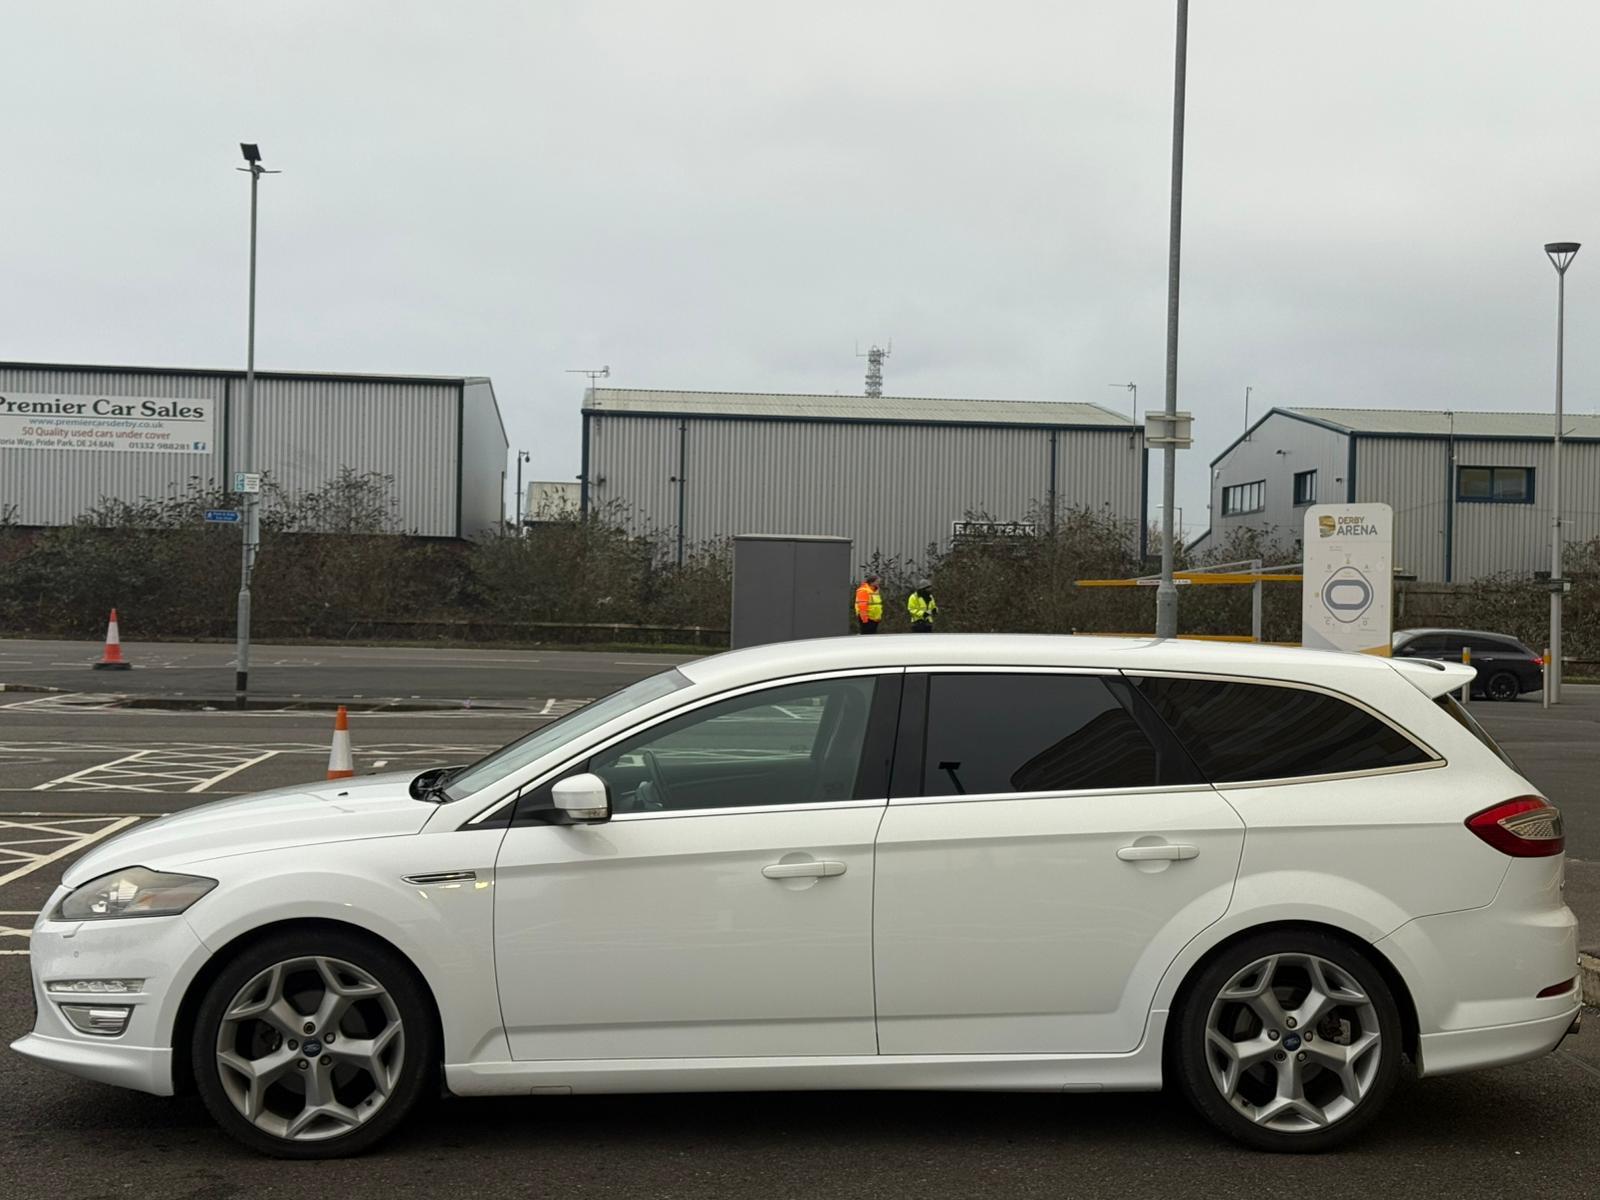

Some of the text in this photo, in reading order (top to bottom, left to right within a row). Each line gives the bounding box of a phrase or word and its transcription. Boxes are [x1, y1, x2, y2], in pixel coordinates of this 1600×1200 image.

[92, 398, 136, 416] Car
[140, 400, 205, 418] Sales
[29, 419, 164, 429] www.premiercarsderby.co.uk
[22, 426, 170, 440] 50 Quality used cars under cover
[1337, 516, 1365, 525] DERBY
[1336, 524, 1378, 536] ARENA
